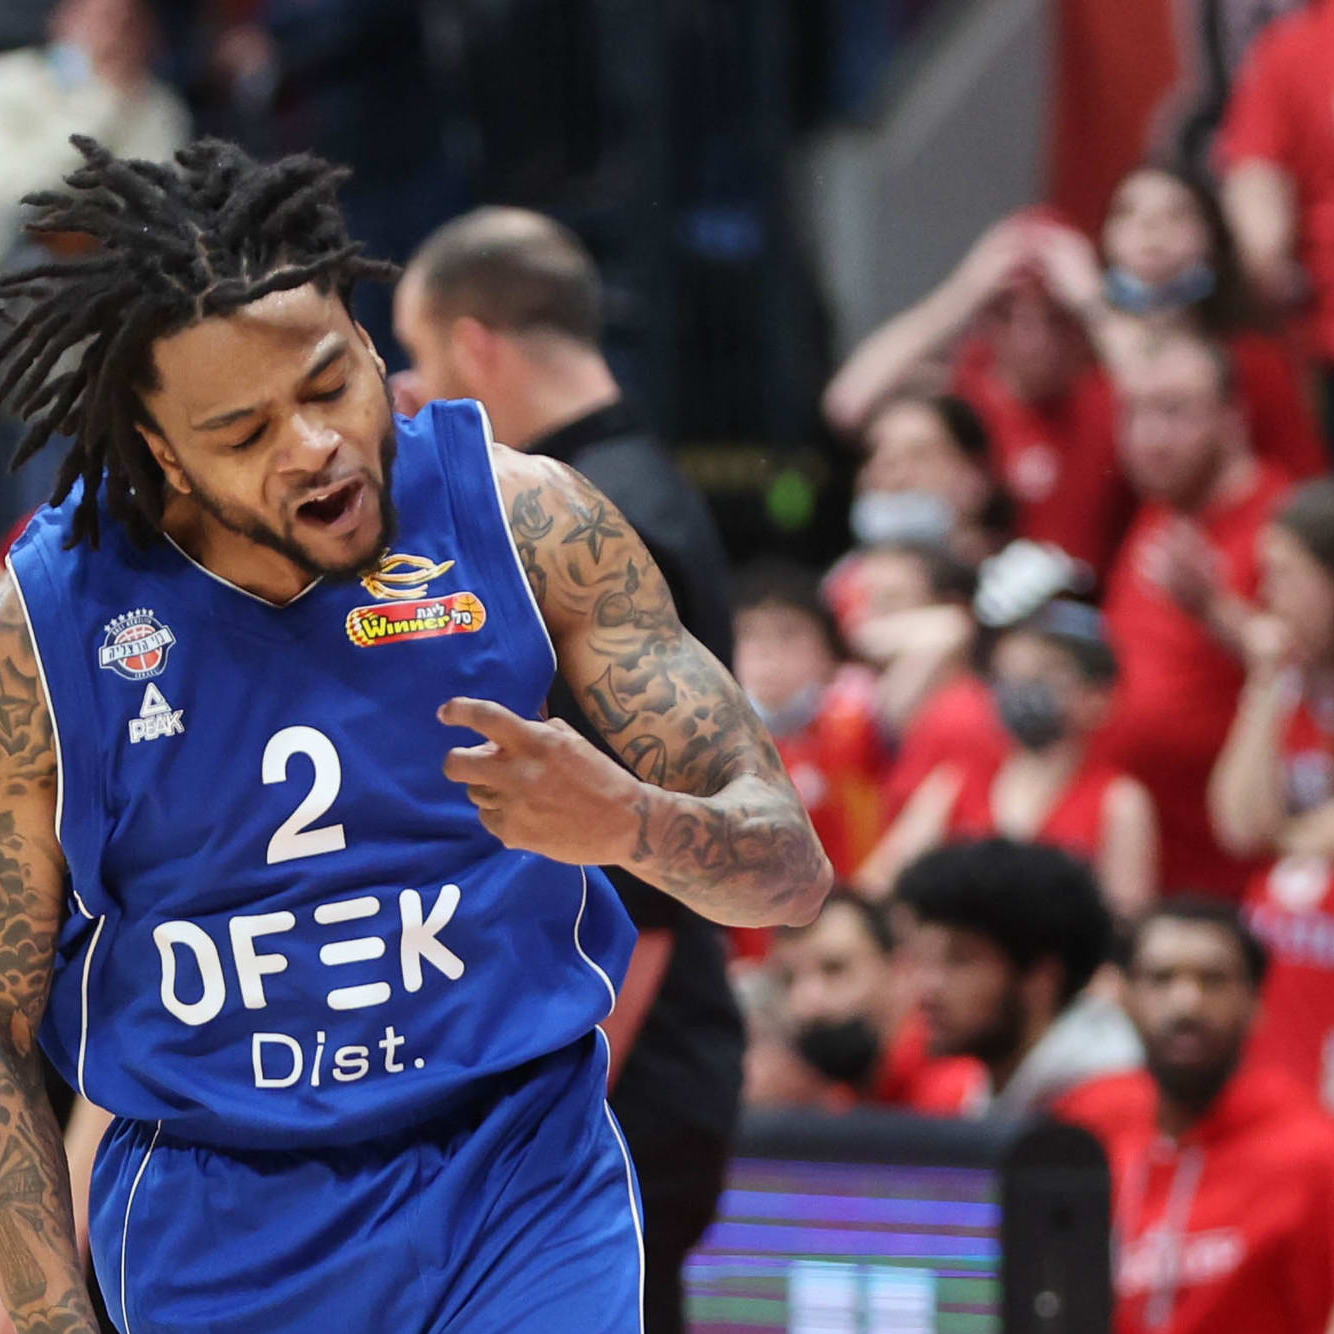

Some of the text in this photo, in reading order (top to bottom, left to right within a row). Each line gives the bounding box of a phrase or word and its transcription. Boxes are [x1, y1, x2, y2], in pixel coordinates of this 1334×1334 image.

[361, 614, 450, 639] Winner
[451, 608, 473, 625] סל
[129, 709, 185, 744] PEAK
[261, 725, 346, 865] 2
[152, 883, 465, 1027] OFEK
[251, 1025, 426, 1088] Dist.
